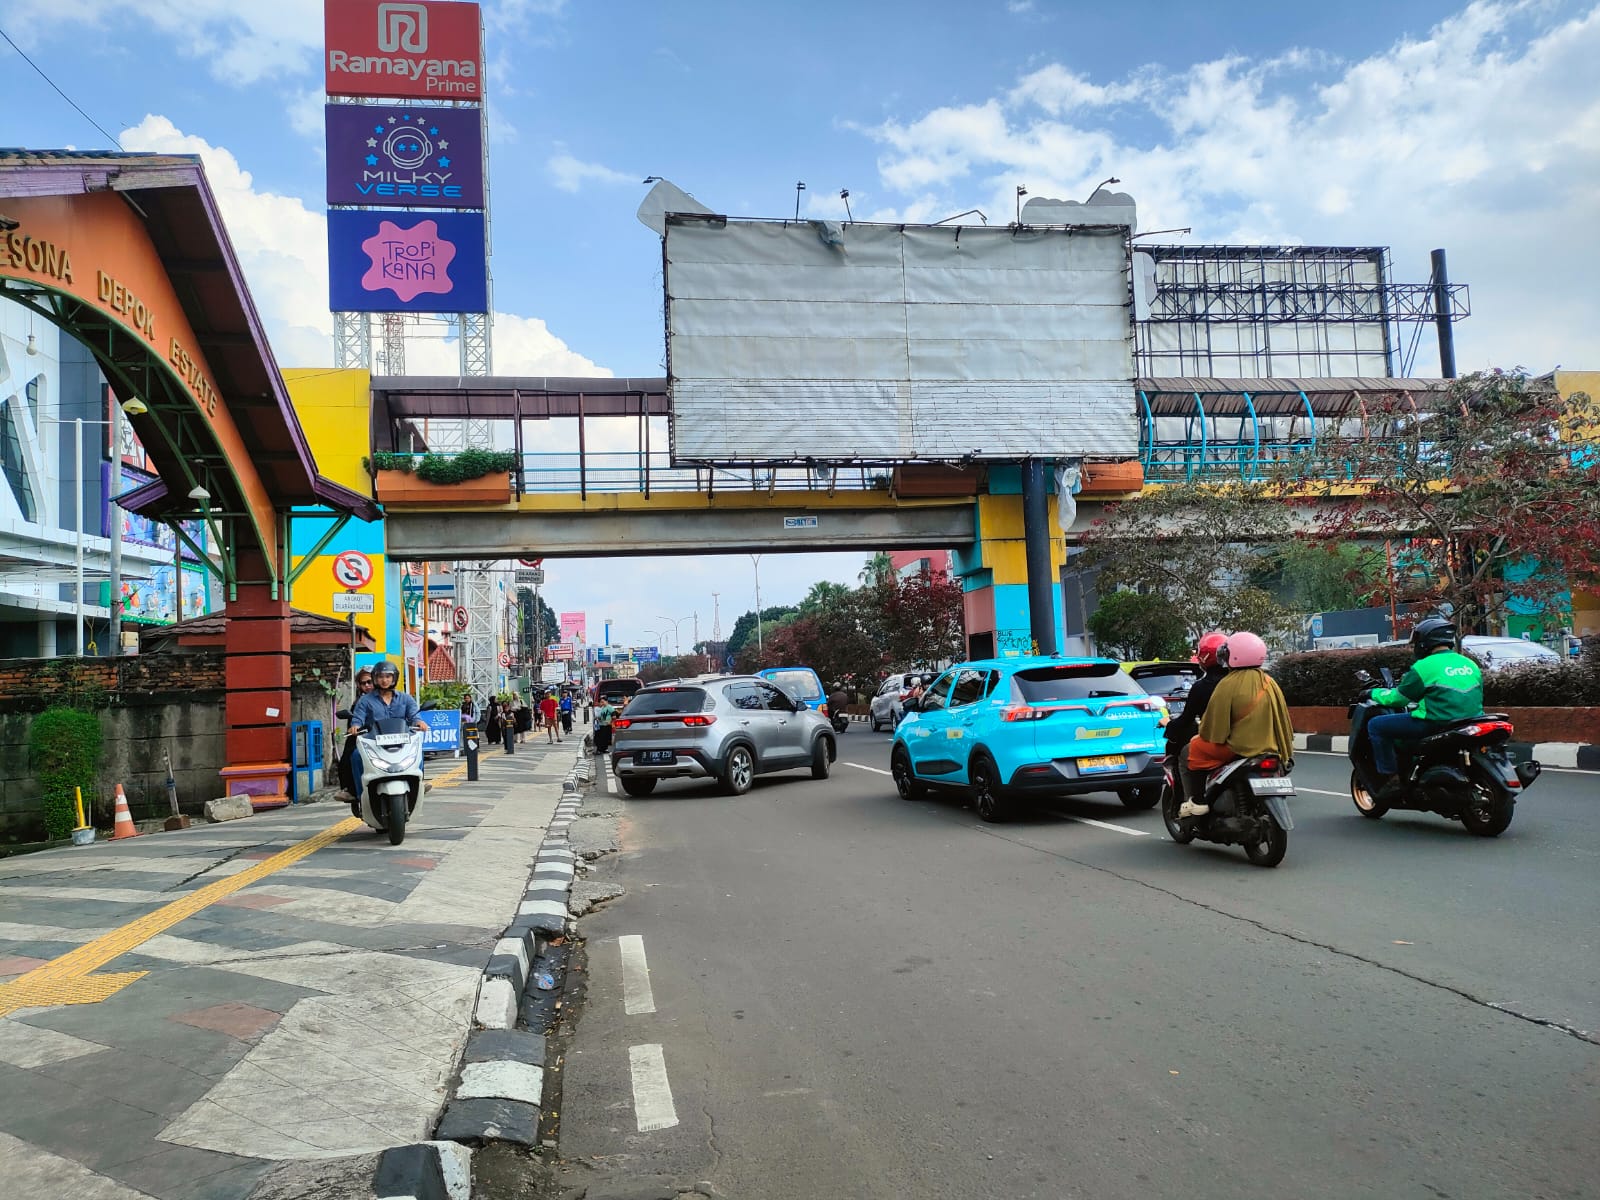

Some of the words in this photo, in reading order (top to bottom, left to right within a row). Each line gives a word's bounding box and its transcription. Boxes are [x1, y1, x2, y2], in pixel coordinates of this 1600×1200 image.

[329, 50, 476, 80] Ramayana
[426, 77, 476, 93] Prime
[363, 170, 453, 184] MILKY
[355, 183, 463, 197] VERSE
[382, 257, 436, 280] KANA
[97, 270, 156, 340] DEPOK
[169, 337, 218, 417] ESTATE
[1445, 665, 1473, 676] Grab
